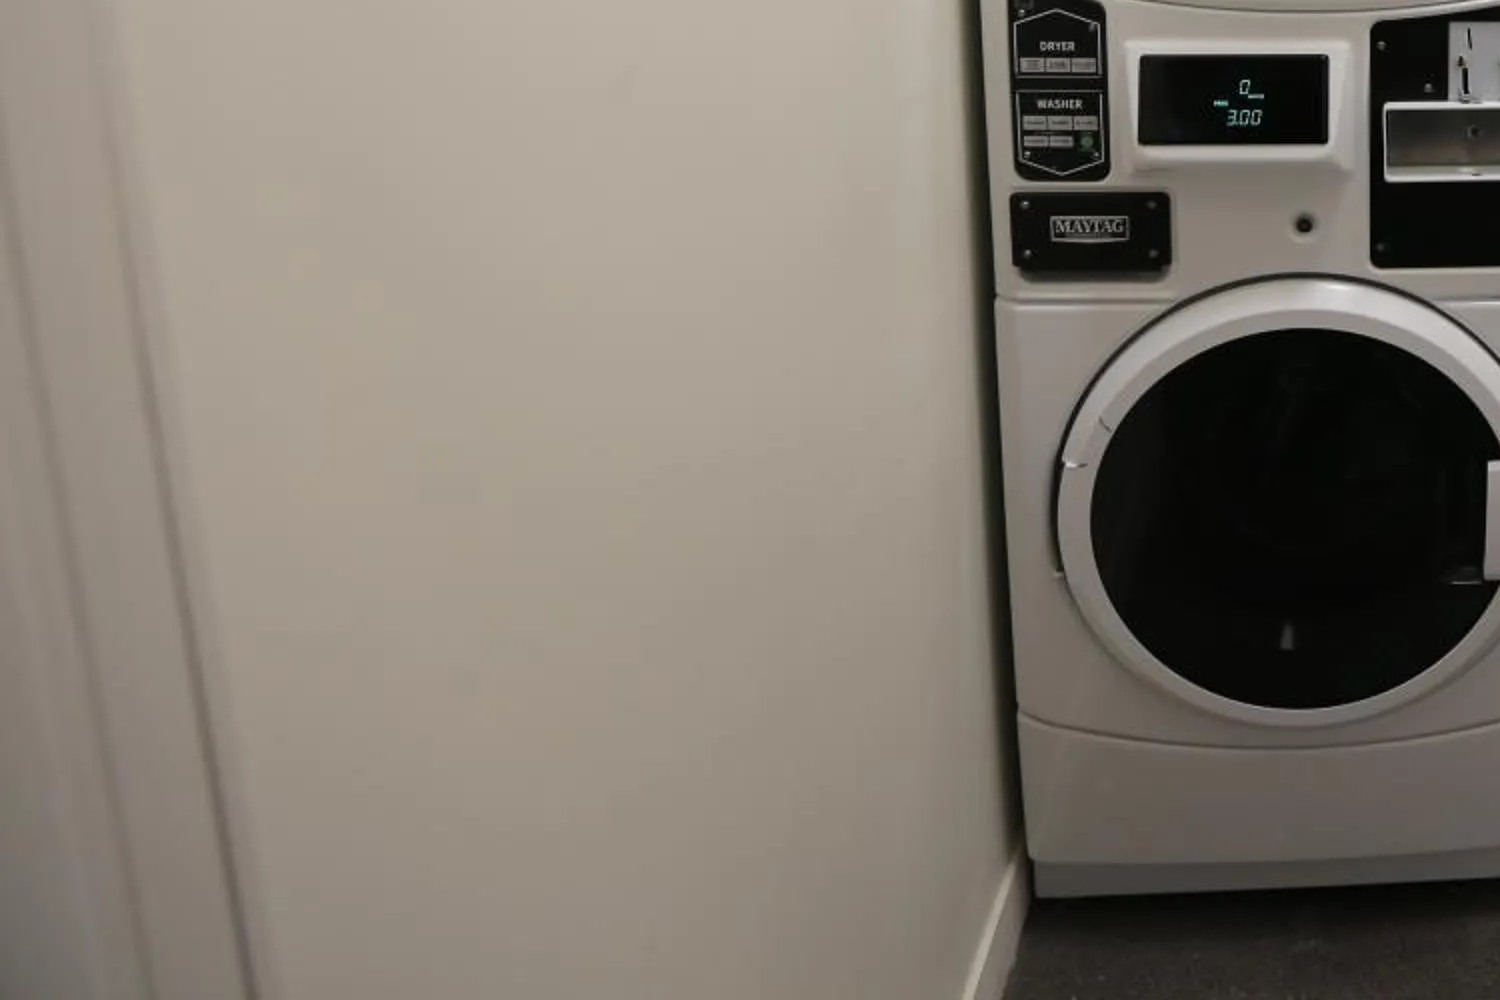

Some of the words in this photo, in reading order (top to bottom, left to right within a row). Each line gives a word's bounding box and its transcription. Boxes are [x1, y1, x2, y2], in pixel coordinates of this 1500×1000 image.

[1039, 41, 1076, 51] DRYER
[1238, 78, 1251, 95] 0
[1037, 99, 1083, 110] WASHER
[1226, 109, 1262, 126] 3.00
[1055, 219, 1124, 234] MAYTAG
